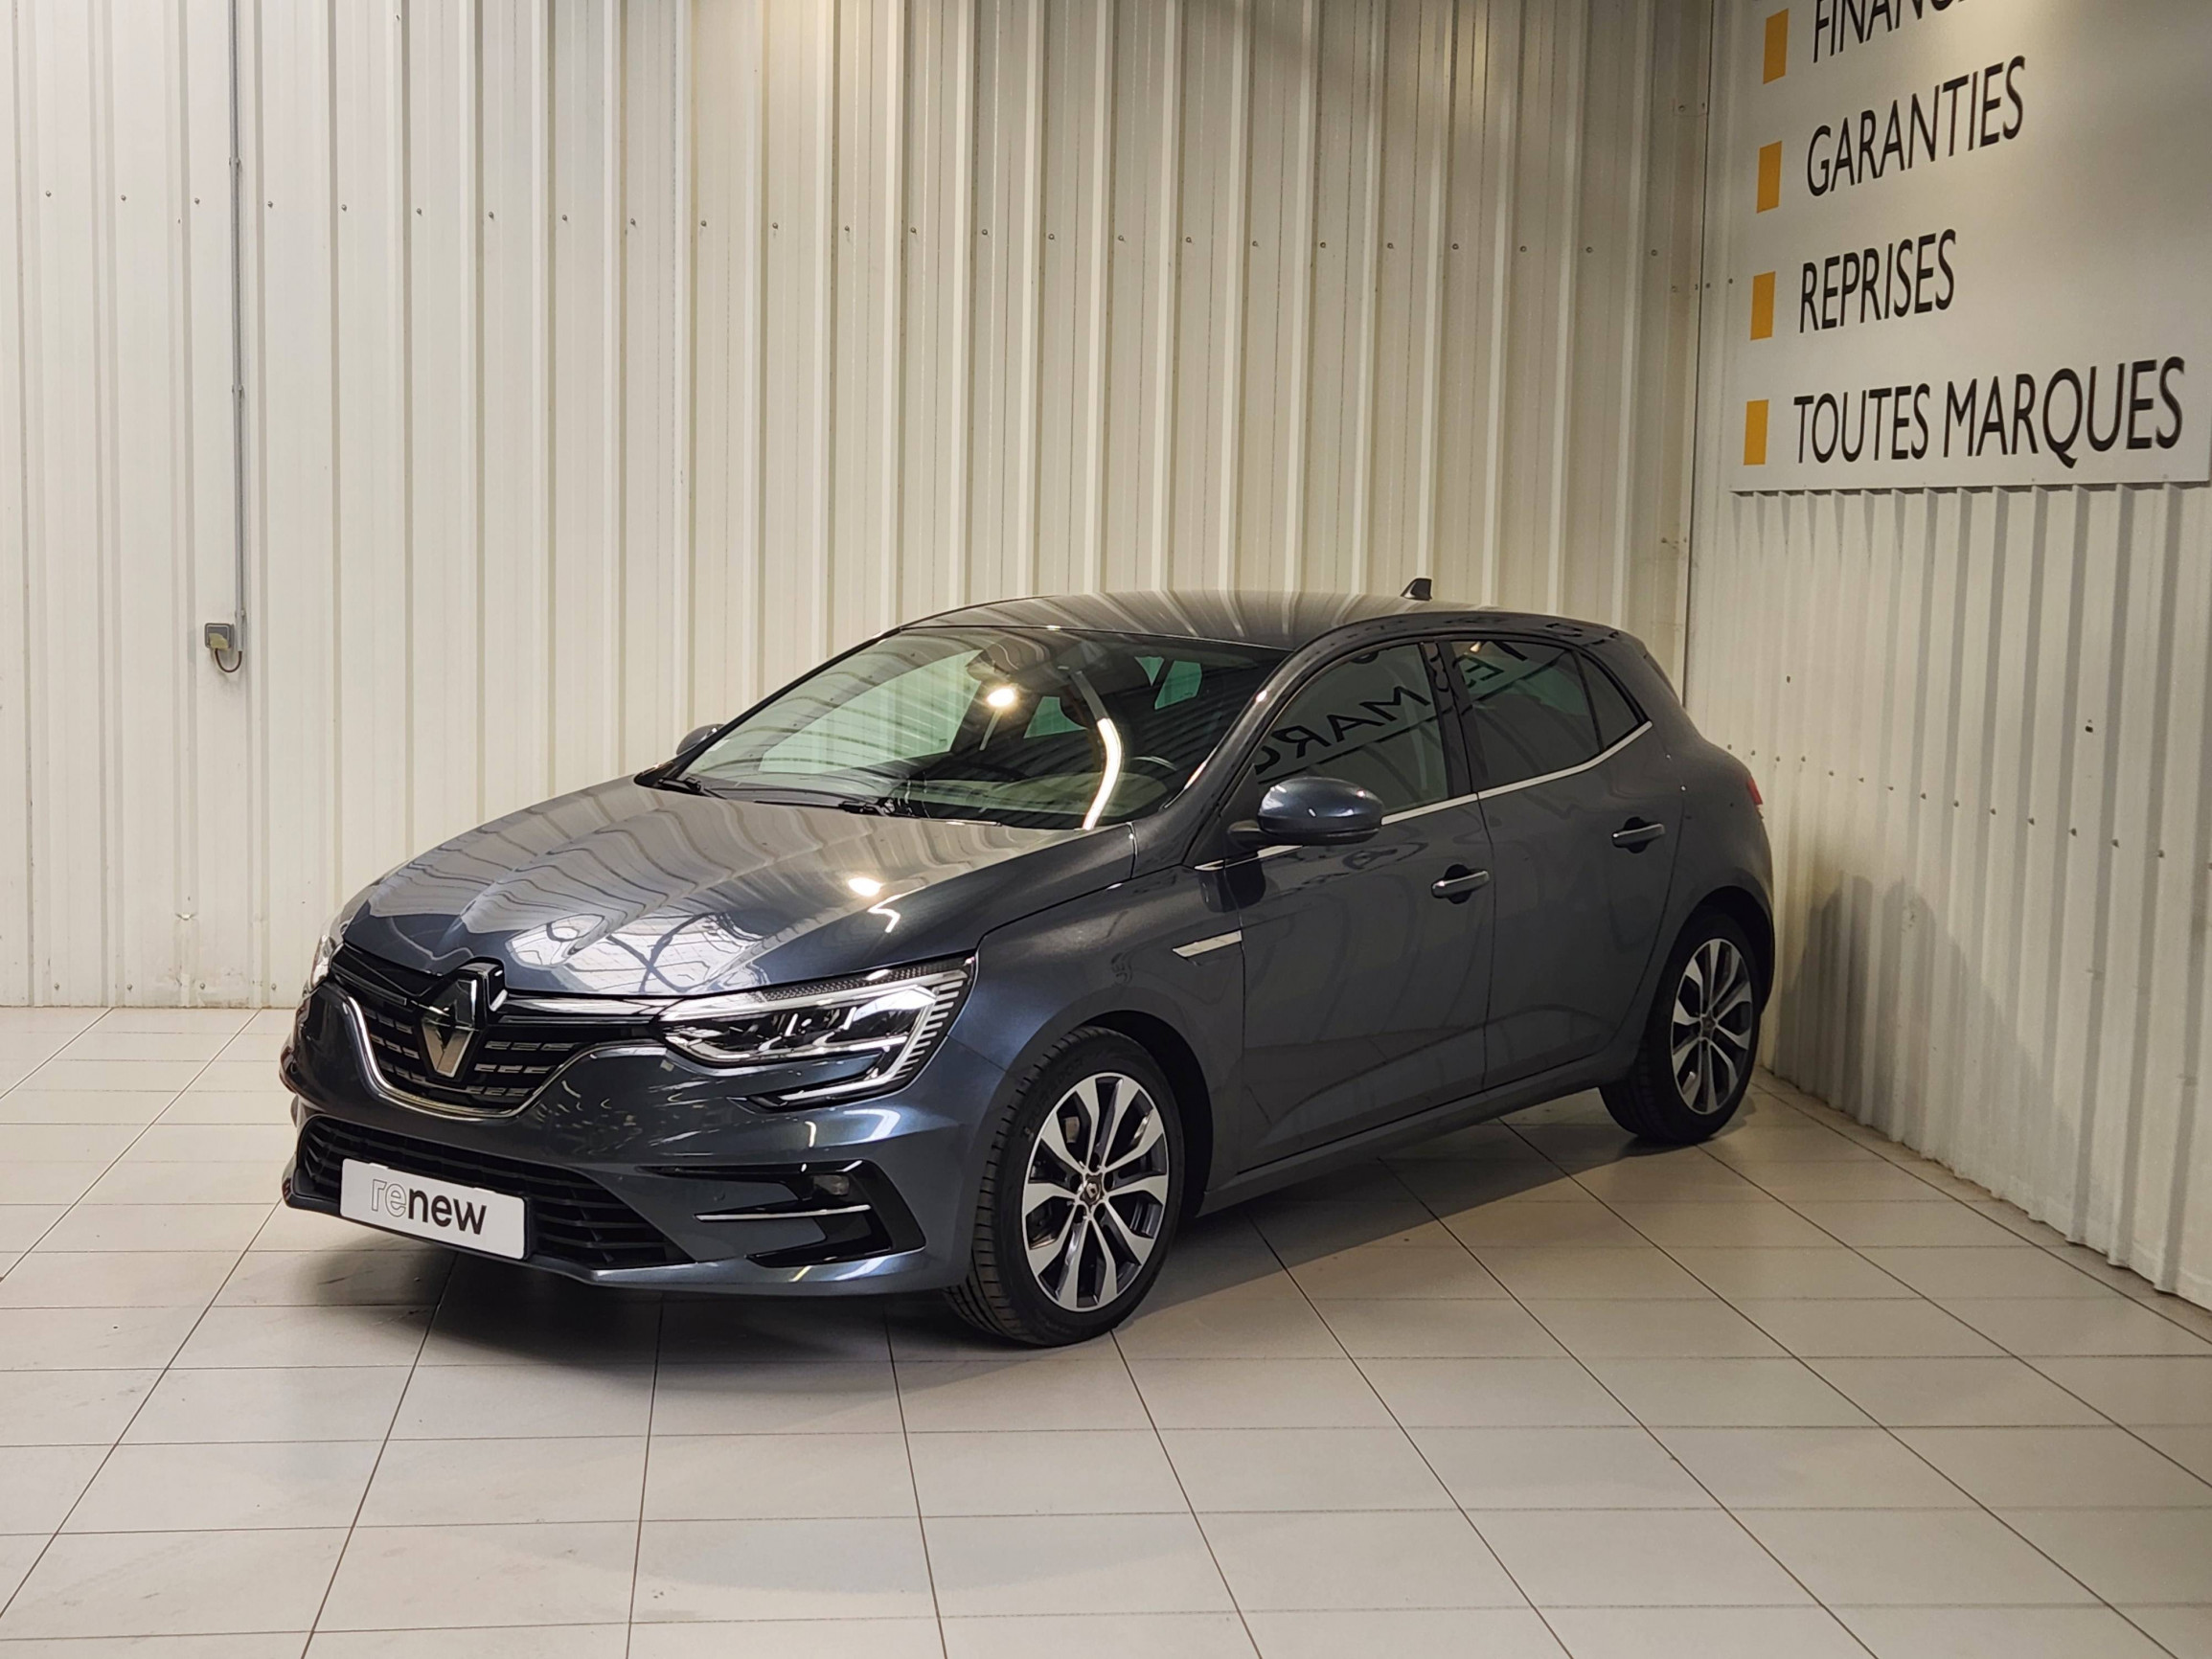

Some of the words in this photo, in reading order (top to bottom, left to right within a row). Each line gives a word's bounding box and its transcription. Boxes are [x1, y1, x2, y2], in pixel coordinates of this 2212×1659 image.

[1808, 55, 2025, 196] GARANTIES
[1800, 229, 1956, 333] REPRISES
[1794, 383, 1930, 464] TOUTES
[1944, 356, 2185, 468] MARQUES
[371, 1178, 487, 1235] renew
